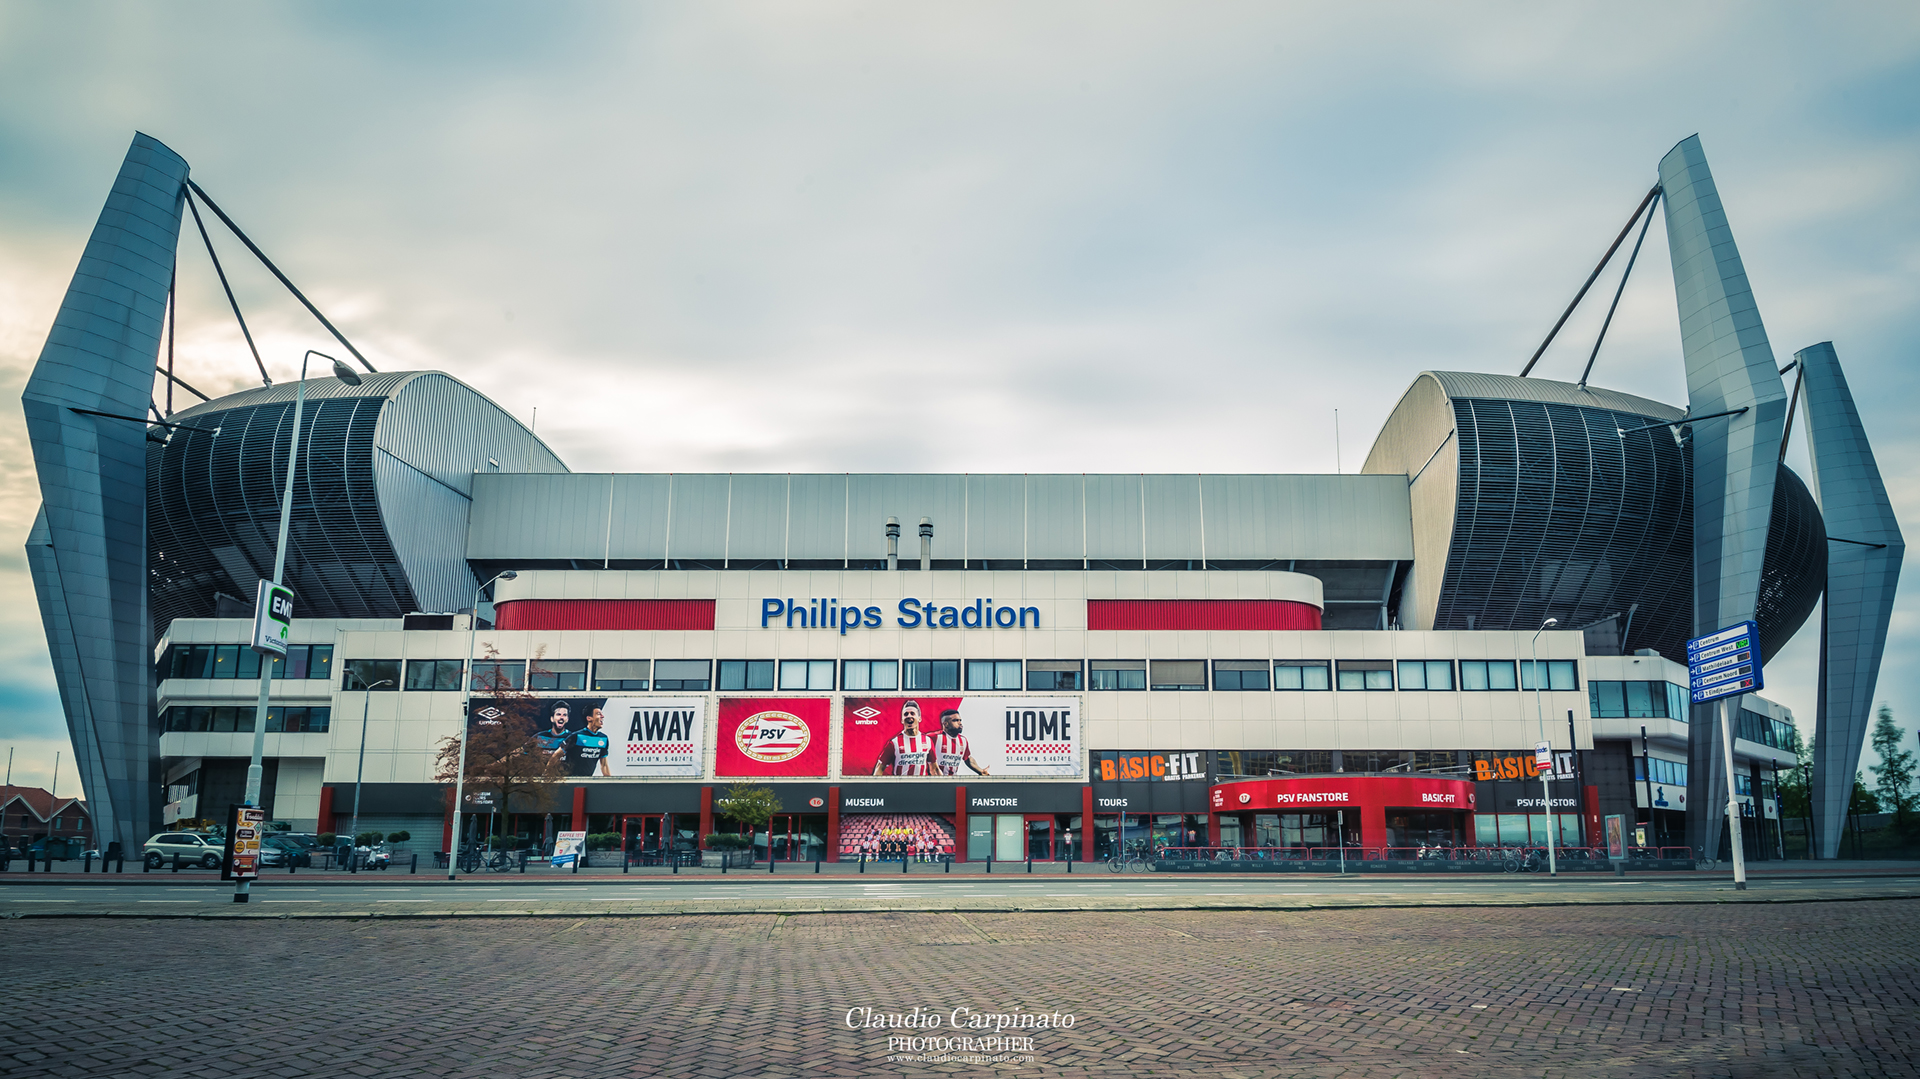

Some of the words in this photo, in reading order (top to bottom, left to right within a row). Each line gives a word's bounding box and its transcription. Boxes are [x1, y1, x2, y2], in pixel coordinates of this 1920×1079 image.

[761, 598, 883, 636] Philips
[897, 598, 1040, 628] Stadion
[1700, 636, 1720, 647] Centrum
[1701, 648, 1721, 659] Centrum
[1721, 644, 1733, 652] West
[1702, 659, 1732, 671] Mathildelaan
[1703, 674, 1723, 684] Centrum
[1723, 670, 1737, 678] Noord
[628, 711, 695, 741] AWAY
[1006, 711, 1071, 741] HOME
[759, 729, 786, 739] PSV
[898, 758, 925, 766] direct.nl
[1100, 752, 1199, 781] BASIC-FIT
[1475, 753, 1572, 781] BASICIT
[845, 798, 884, 806] MUSEUM
[972, 798, 1018, 806] FANSTORE
[1099, 798, 1128, 806] TOURS
[1277, 794, 1295, 803] PSV
[1297, 792, 1349, 802] FANSTORE
[1422, 793, 1455, 803] BASIC-FIT
[1517, 798, 1533, 807] PSV
[1535, 798, 1577, 807] FANSTOR
